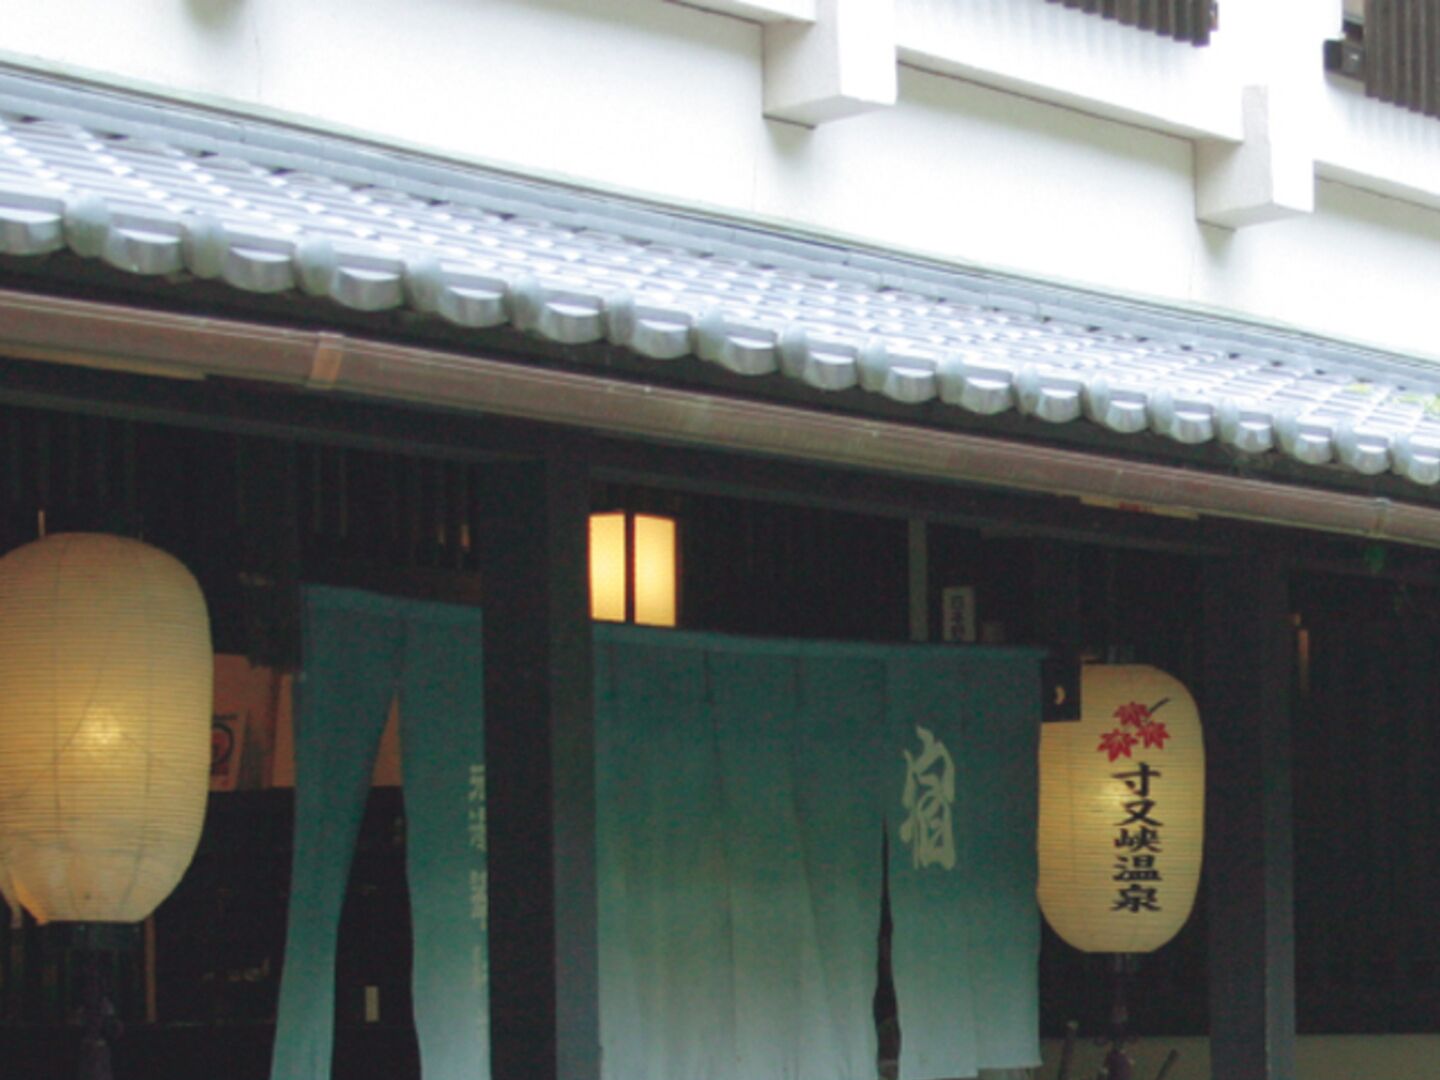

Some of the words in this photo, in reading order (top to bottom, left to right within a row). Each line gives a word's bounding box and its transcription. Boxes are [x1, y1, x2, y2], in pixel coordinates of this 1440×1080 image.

[1110, 761, 1164, 913] 寸又峡温泉
